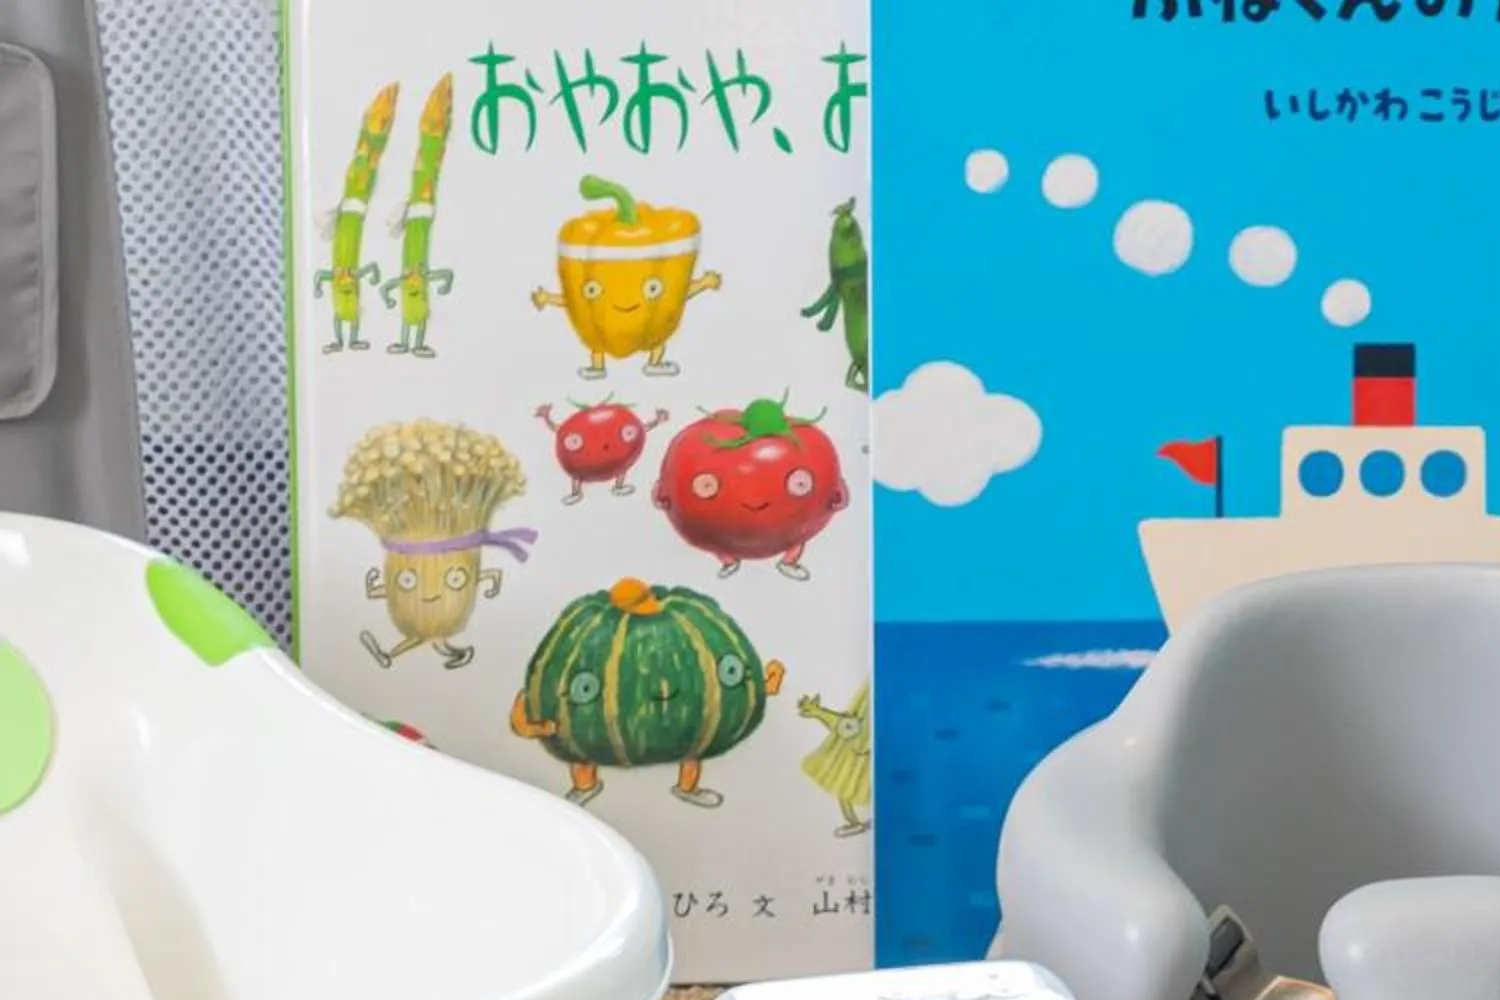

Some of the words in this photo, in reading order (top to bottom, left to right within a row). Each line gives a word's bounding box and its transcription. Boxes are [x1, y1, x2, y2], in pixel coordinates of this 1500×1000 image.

[672, 891, 730, 918] ひろ
[752, 894, 777, 918] 文
[812, 889, 873, 916] 山村
